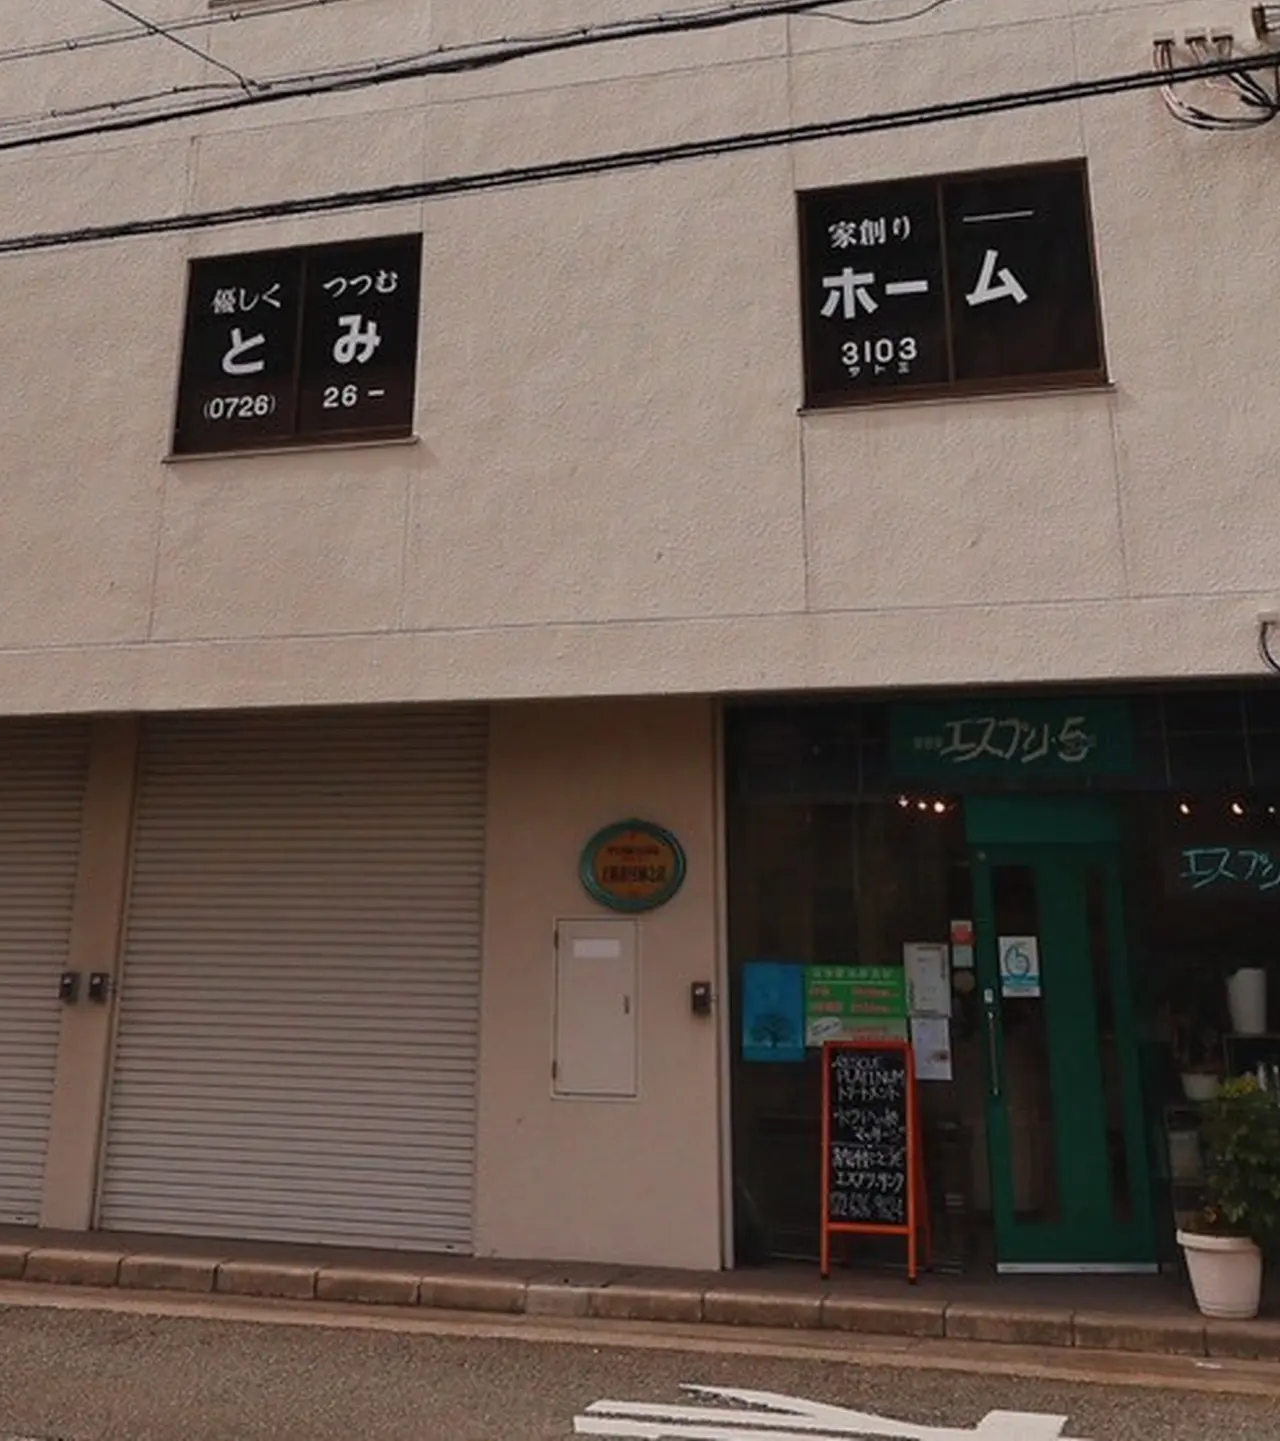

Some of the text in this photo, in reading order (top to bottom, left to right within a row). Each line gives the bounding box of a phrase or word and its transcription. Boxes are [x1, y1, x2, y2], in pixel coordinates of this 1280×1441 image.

[211, 282, 281, 314] 優しく
[322, 269, 398, 298] つつむ
[827, 215, 912, 249] 家創り
[841, 336, 918, 366] 3103
